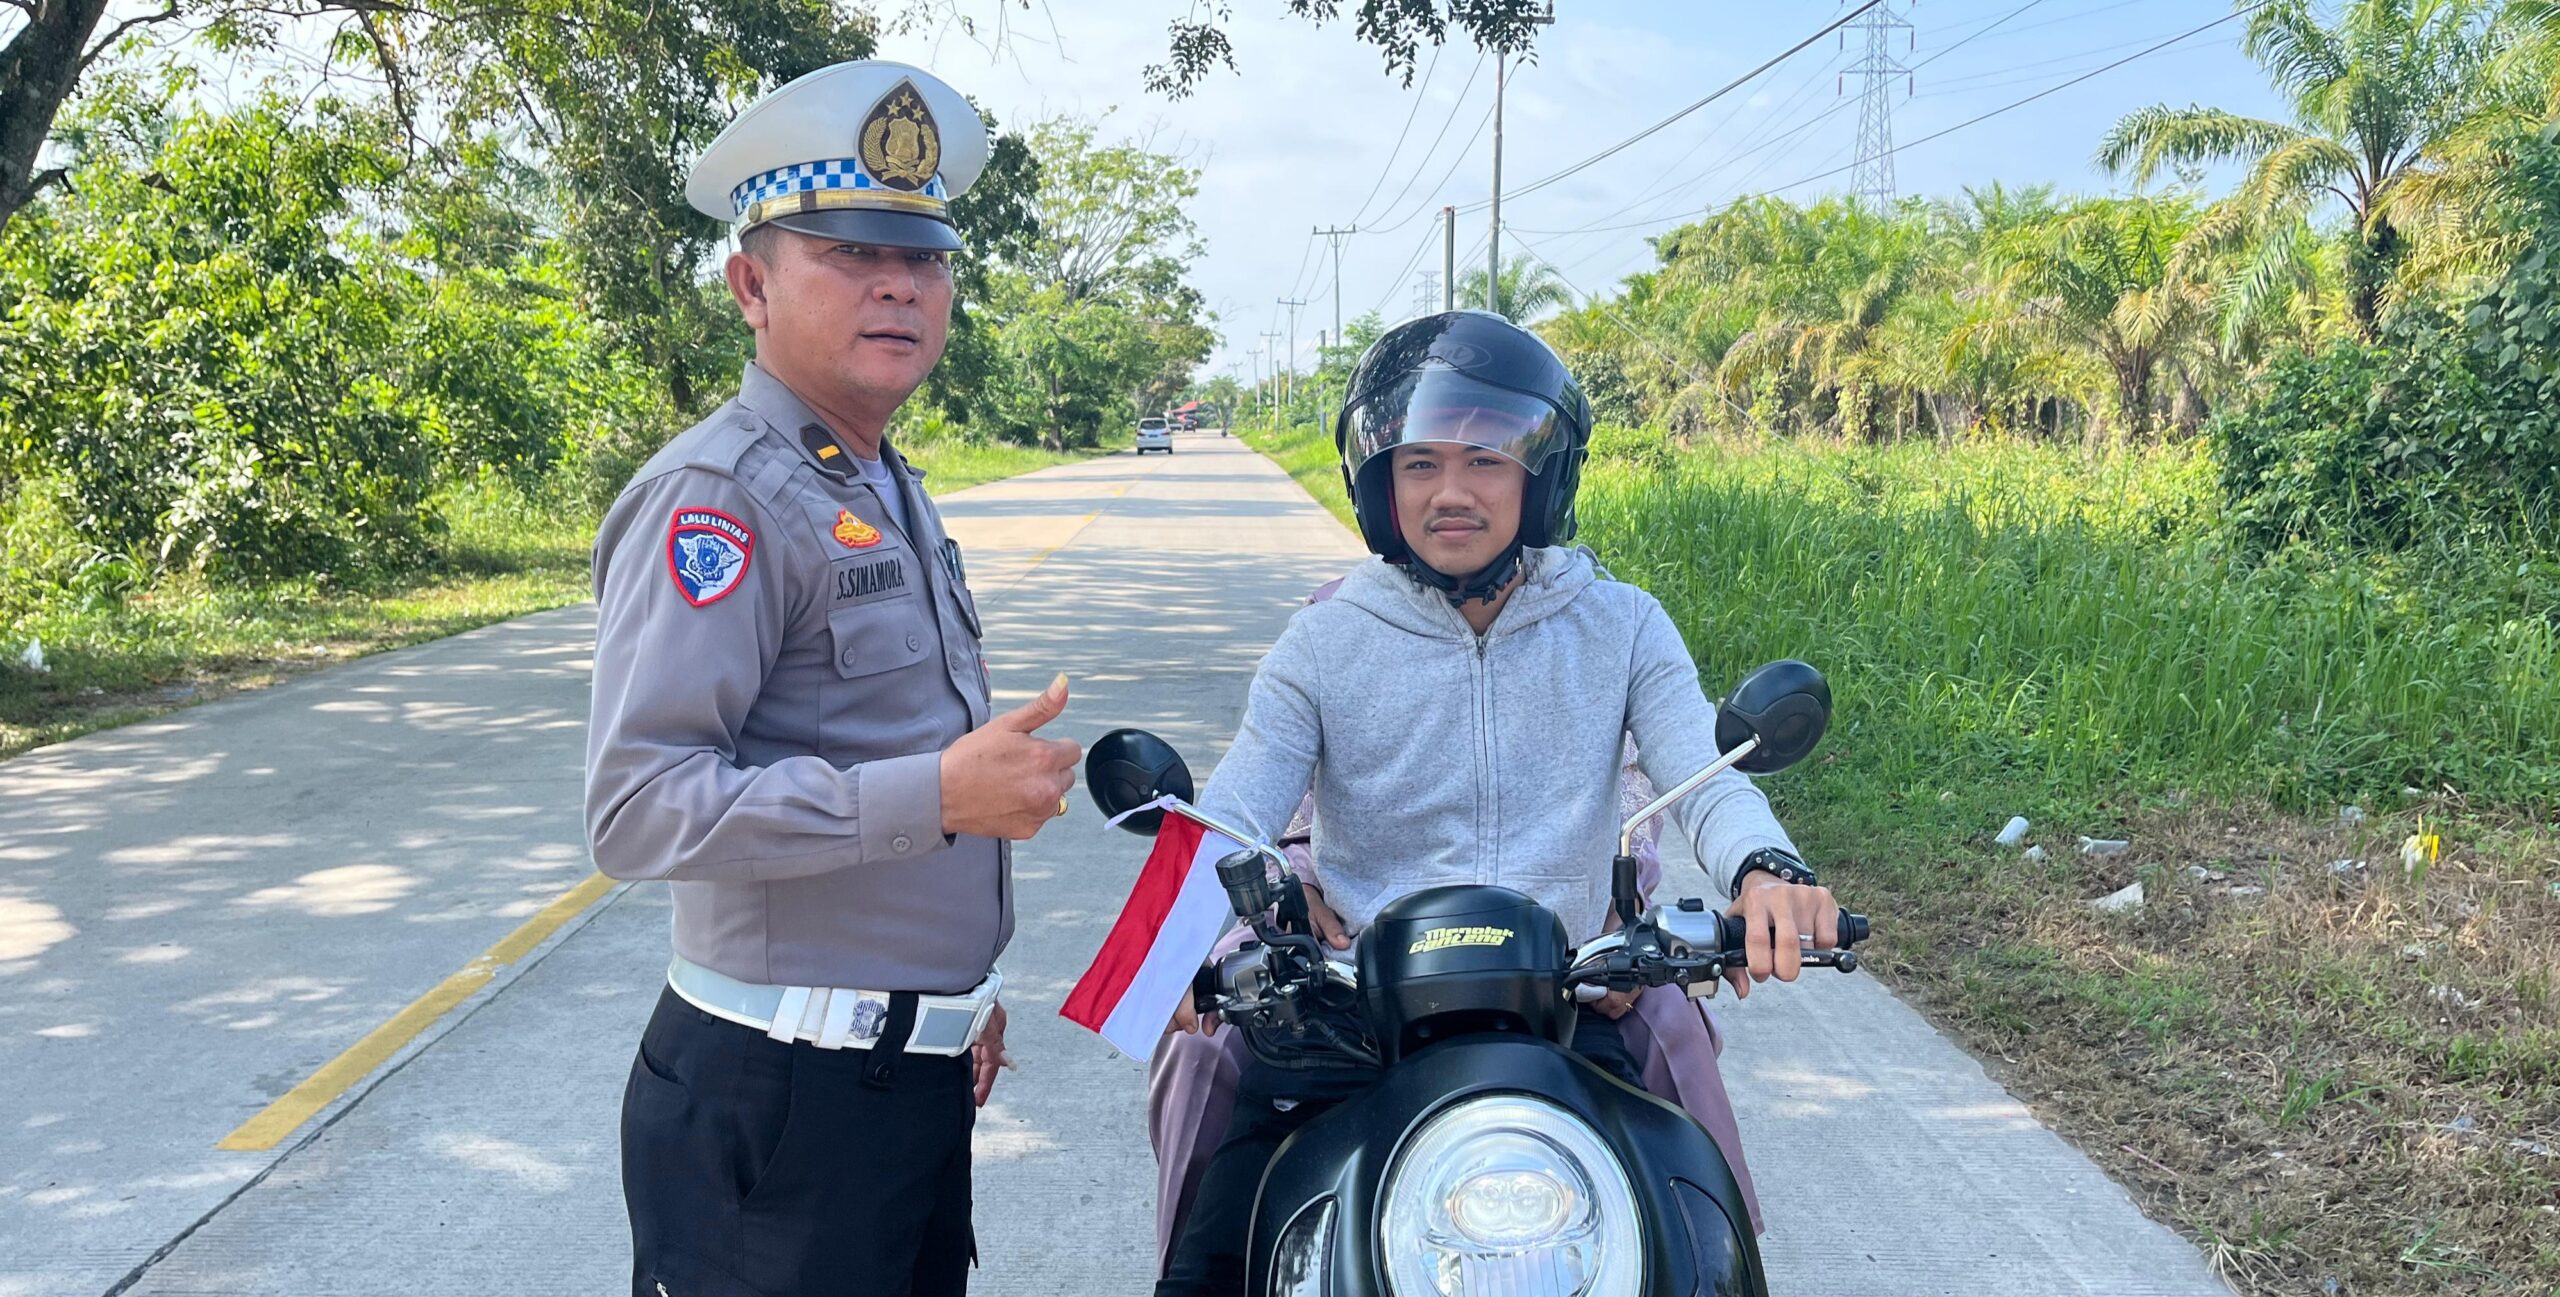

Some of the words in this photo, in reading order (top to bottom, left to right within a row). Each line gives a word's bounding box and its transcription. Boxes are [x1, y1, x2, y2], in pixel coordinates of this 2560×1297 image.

[680, 513, 709, 525] LALU
[711, 516, 749, 543] LINTAS
[836, 557, 905, 600] S.SIMAMORA
